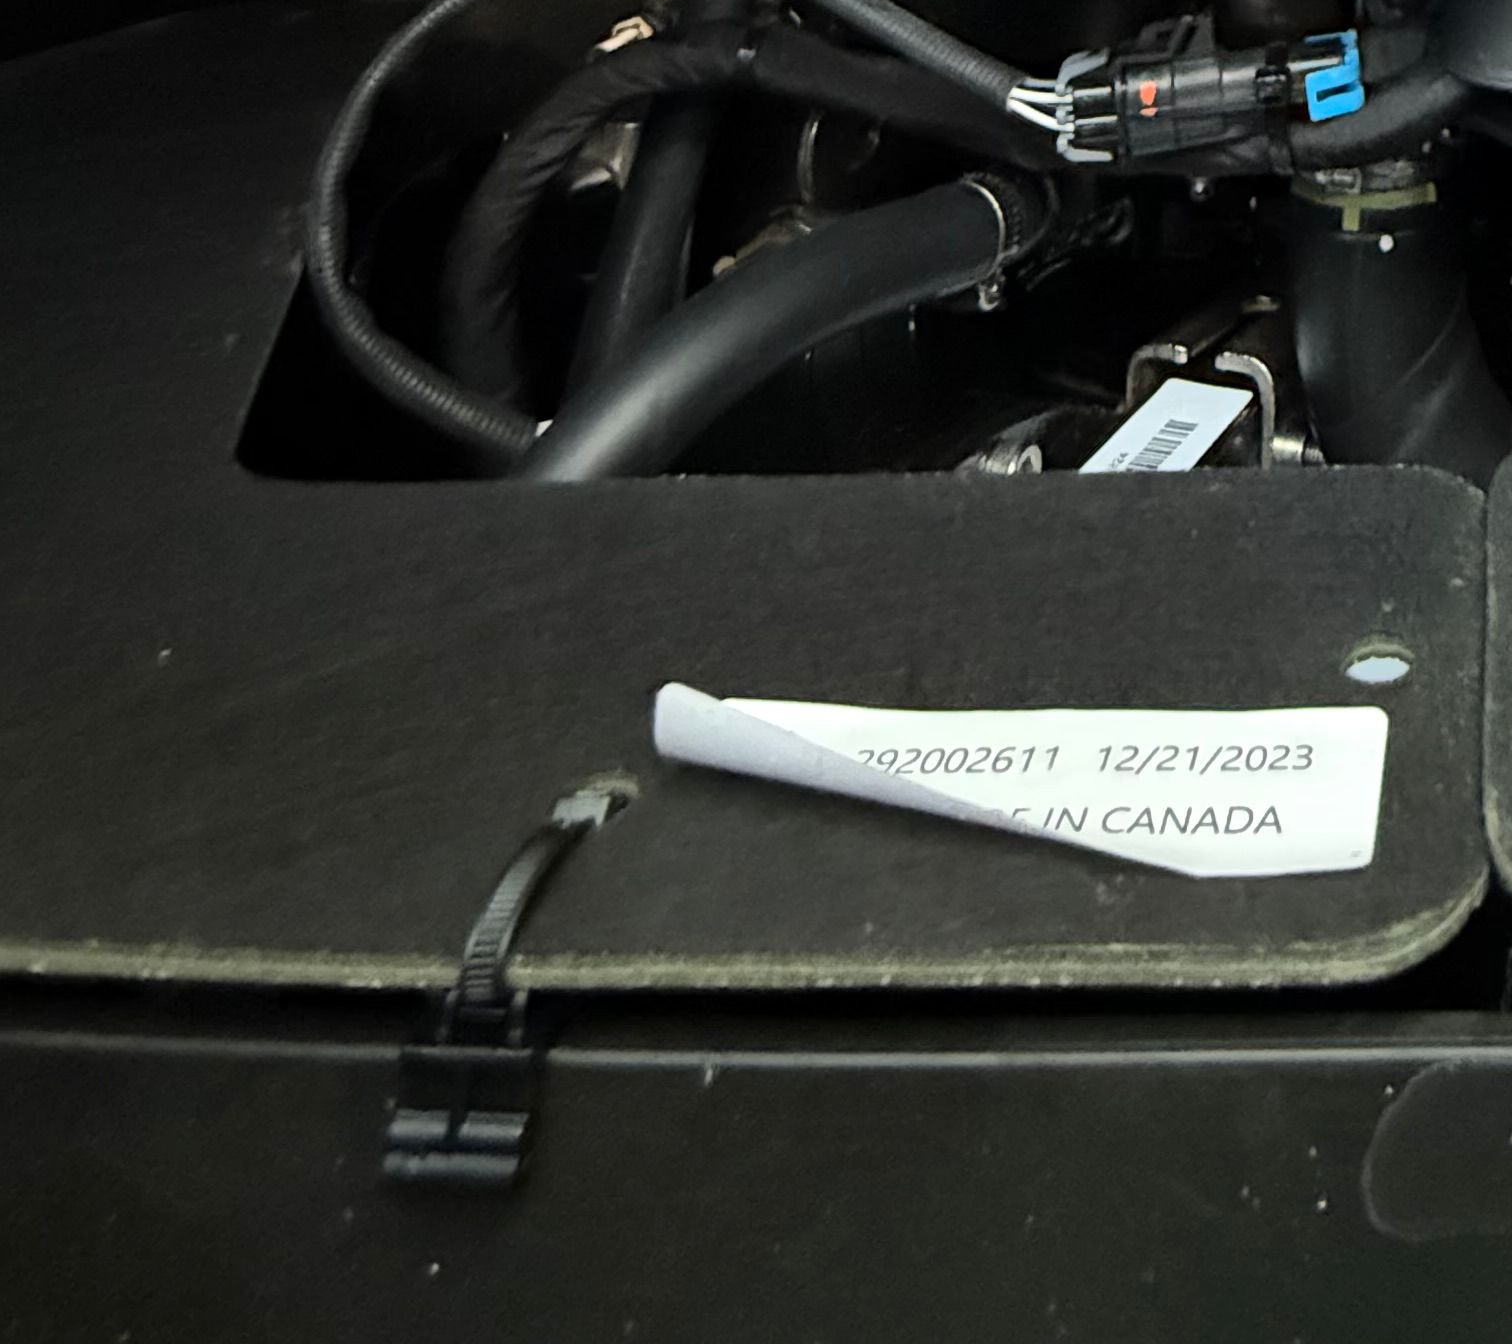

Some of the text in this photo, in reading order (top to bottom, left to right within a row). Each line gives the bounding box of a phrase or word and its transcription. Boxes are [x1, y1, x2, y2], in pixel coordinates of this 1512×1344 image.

[1099, 744, 1315, 777] 12/21/2023
[1043, 806, 1088, 834] IN
[1101, 805, 1283, 836] CANADA
